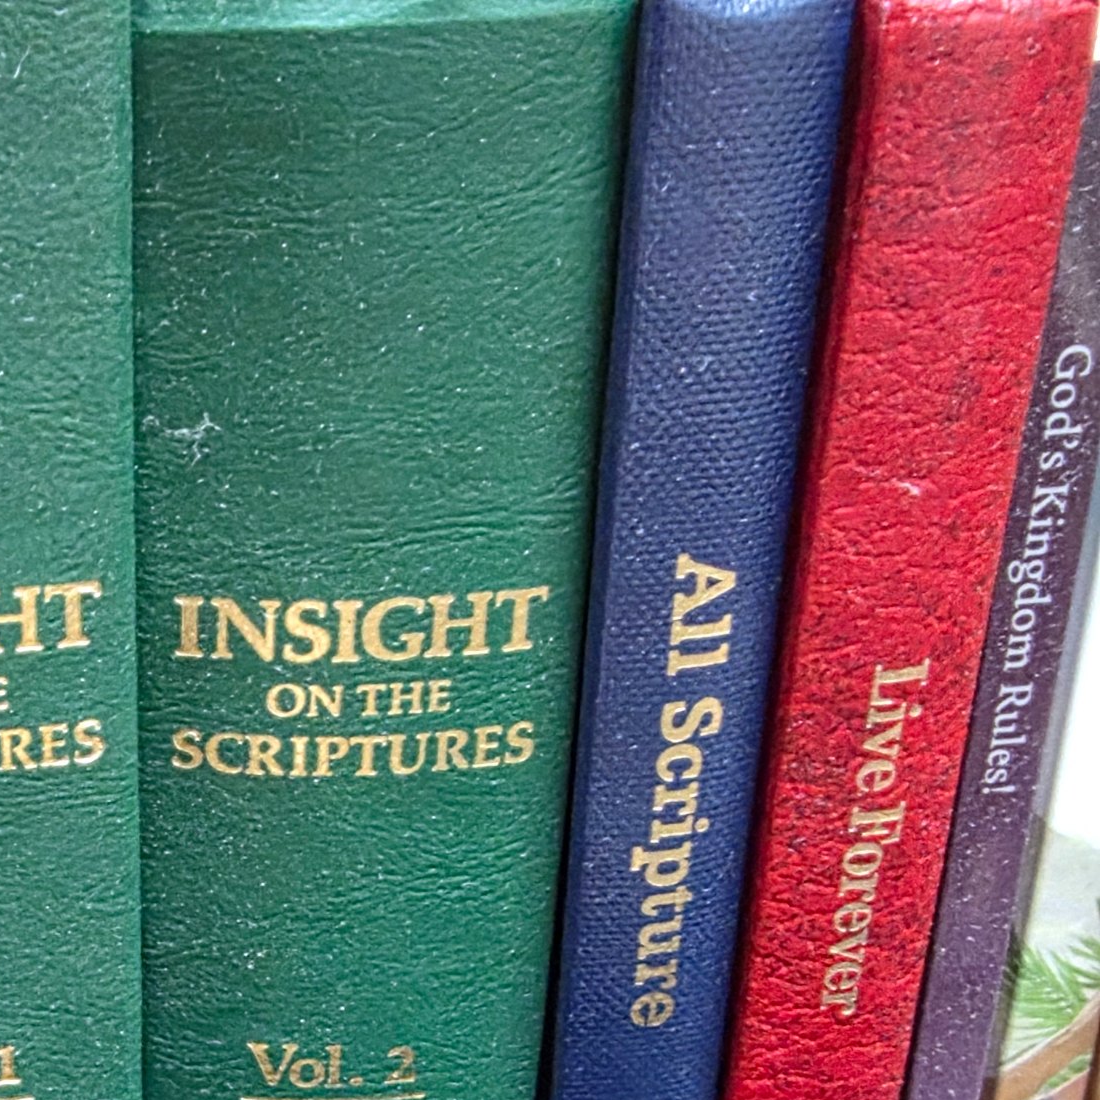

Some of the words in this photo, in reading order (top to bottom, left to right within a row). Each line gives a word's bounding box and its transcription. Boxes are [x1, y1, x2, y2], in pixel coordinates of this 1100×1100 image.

[1041, 343, 1094, 472] God's
[174, 586, 550, 664] INSIGHT
[666, 553, 737, 677] All
[1003, 481, 1073, 674] Kingdom
[170, 721, 536, 777] SCRIPTURES
[266, 682, 345, 718] ON
[356, 679, 452, 714] THE
[854, 657, 930, 794] Live
[982, 683, 1033, 796] Rules!
[629, 695, 723, 1029] Scripture
[820, 800, 907, 1019] Forever
[247, 1041, 364, 1088] Vol.
[384, 1045, 419, 1085] 2
